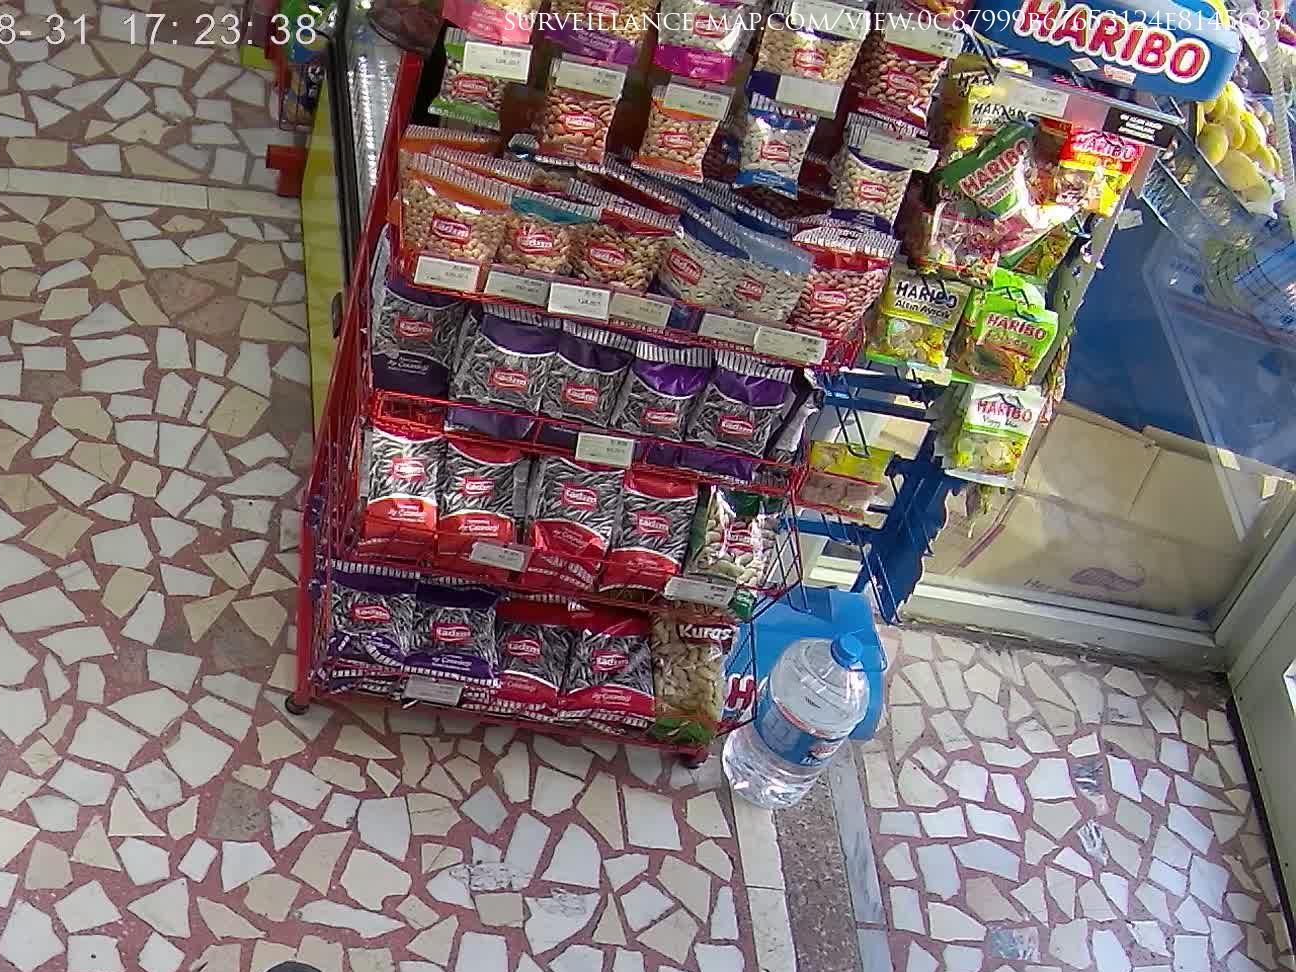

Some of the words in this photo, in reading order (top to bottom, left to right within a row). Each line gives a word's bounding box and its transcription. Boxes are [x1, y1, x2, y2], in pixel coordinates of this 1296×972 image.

[1015, 0, 1209, 82] HARIBO
[896, 281, 958, 309] HARIBO
[987, 313, 1046, 341] HARIBO
